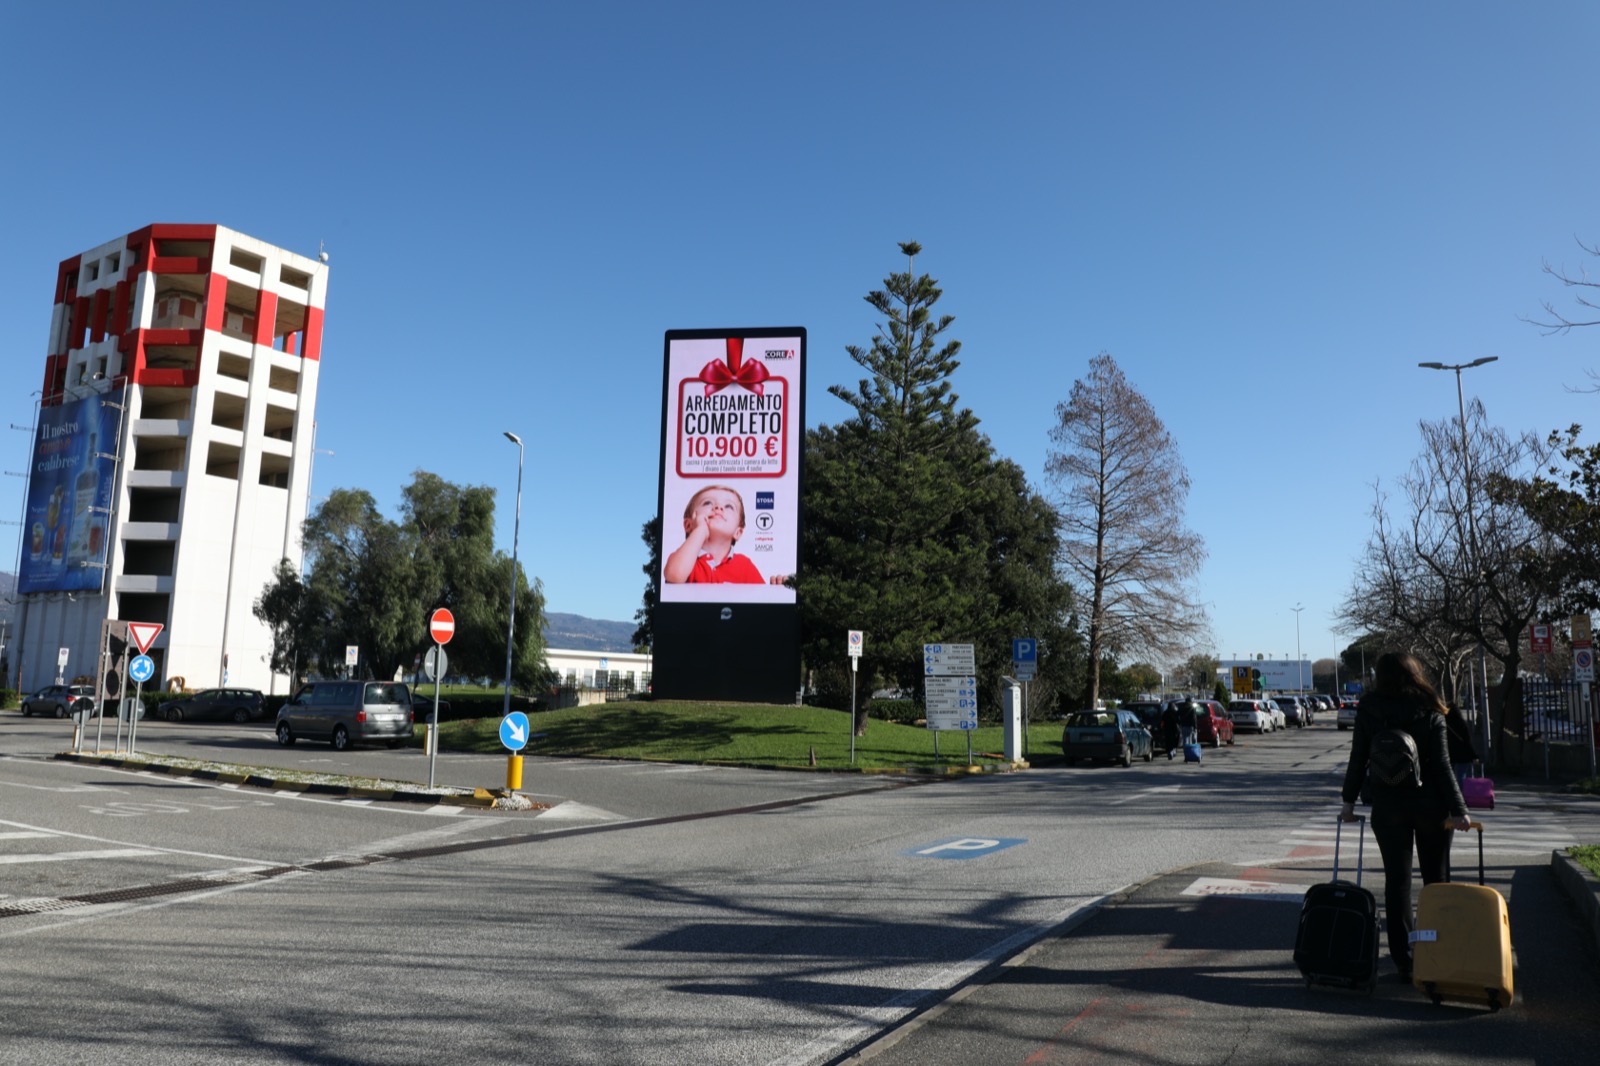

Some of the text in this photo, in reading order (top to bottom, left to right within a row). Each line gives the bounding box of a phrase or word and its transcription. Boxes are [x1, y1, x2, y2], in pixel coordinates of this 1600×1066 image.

[686, 394, 782, 412] ARREDAMENTO
[42, 421, 79, 439] Il nostro
[685, 412, 781, 435] COMPLETO
[686, 436, 779, 458] 10.900 €
[37, 454, 80, 473] calabrese
[1018, 642, 1031, 658] P
